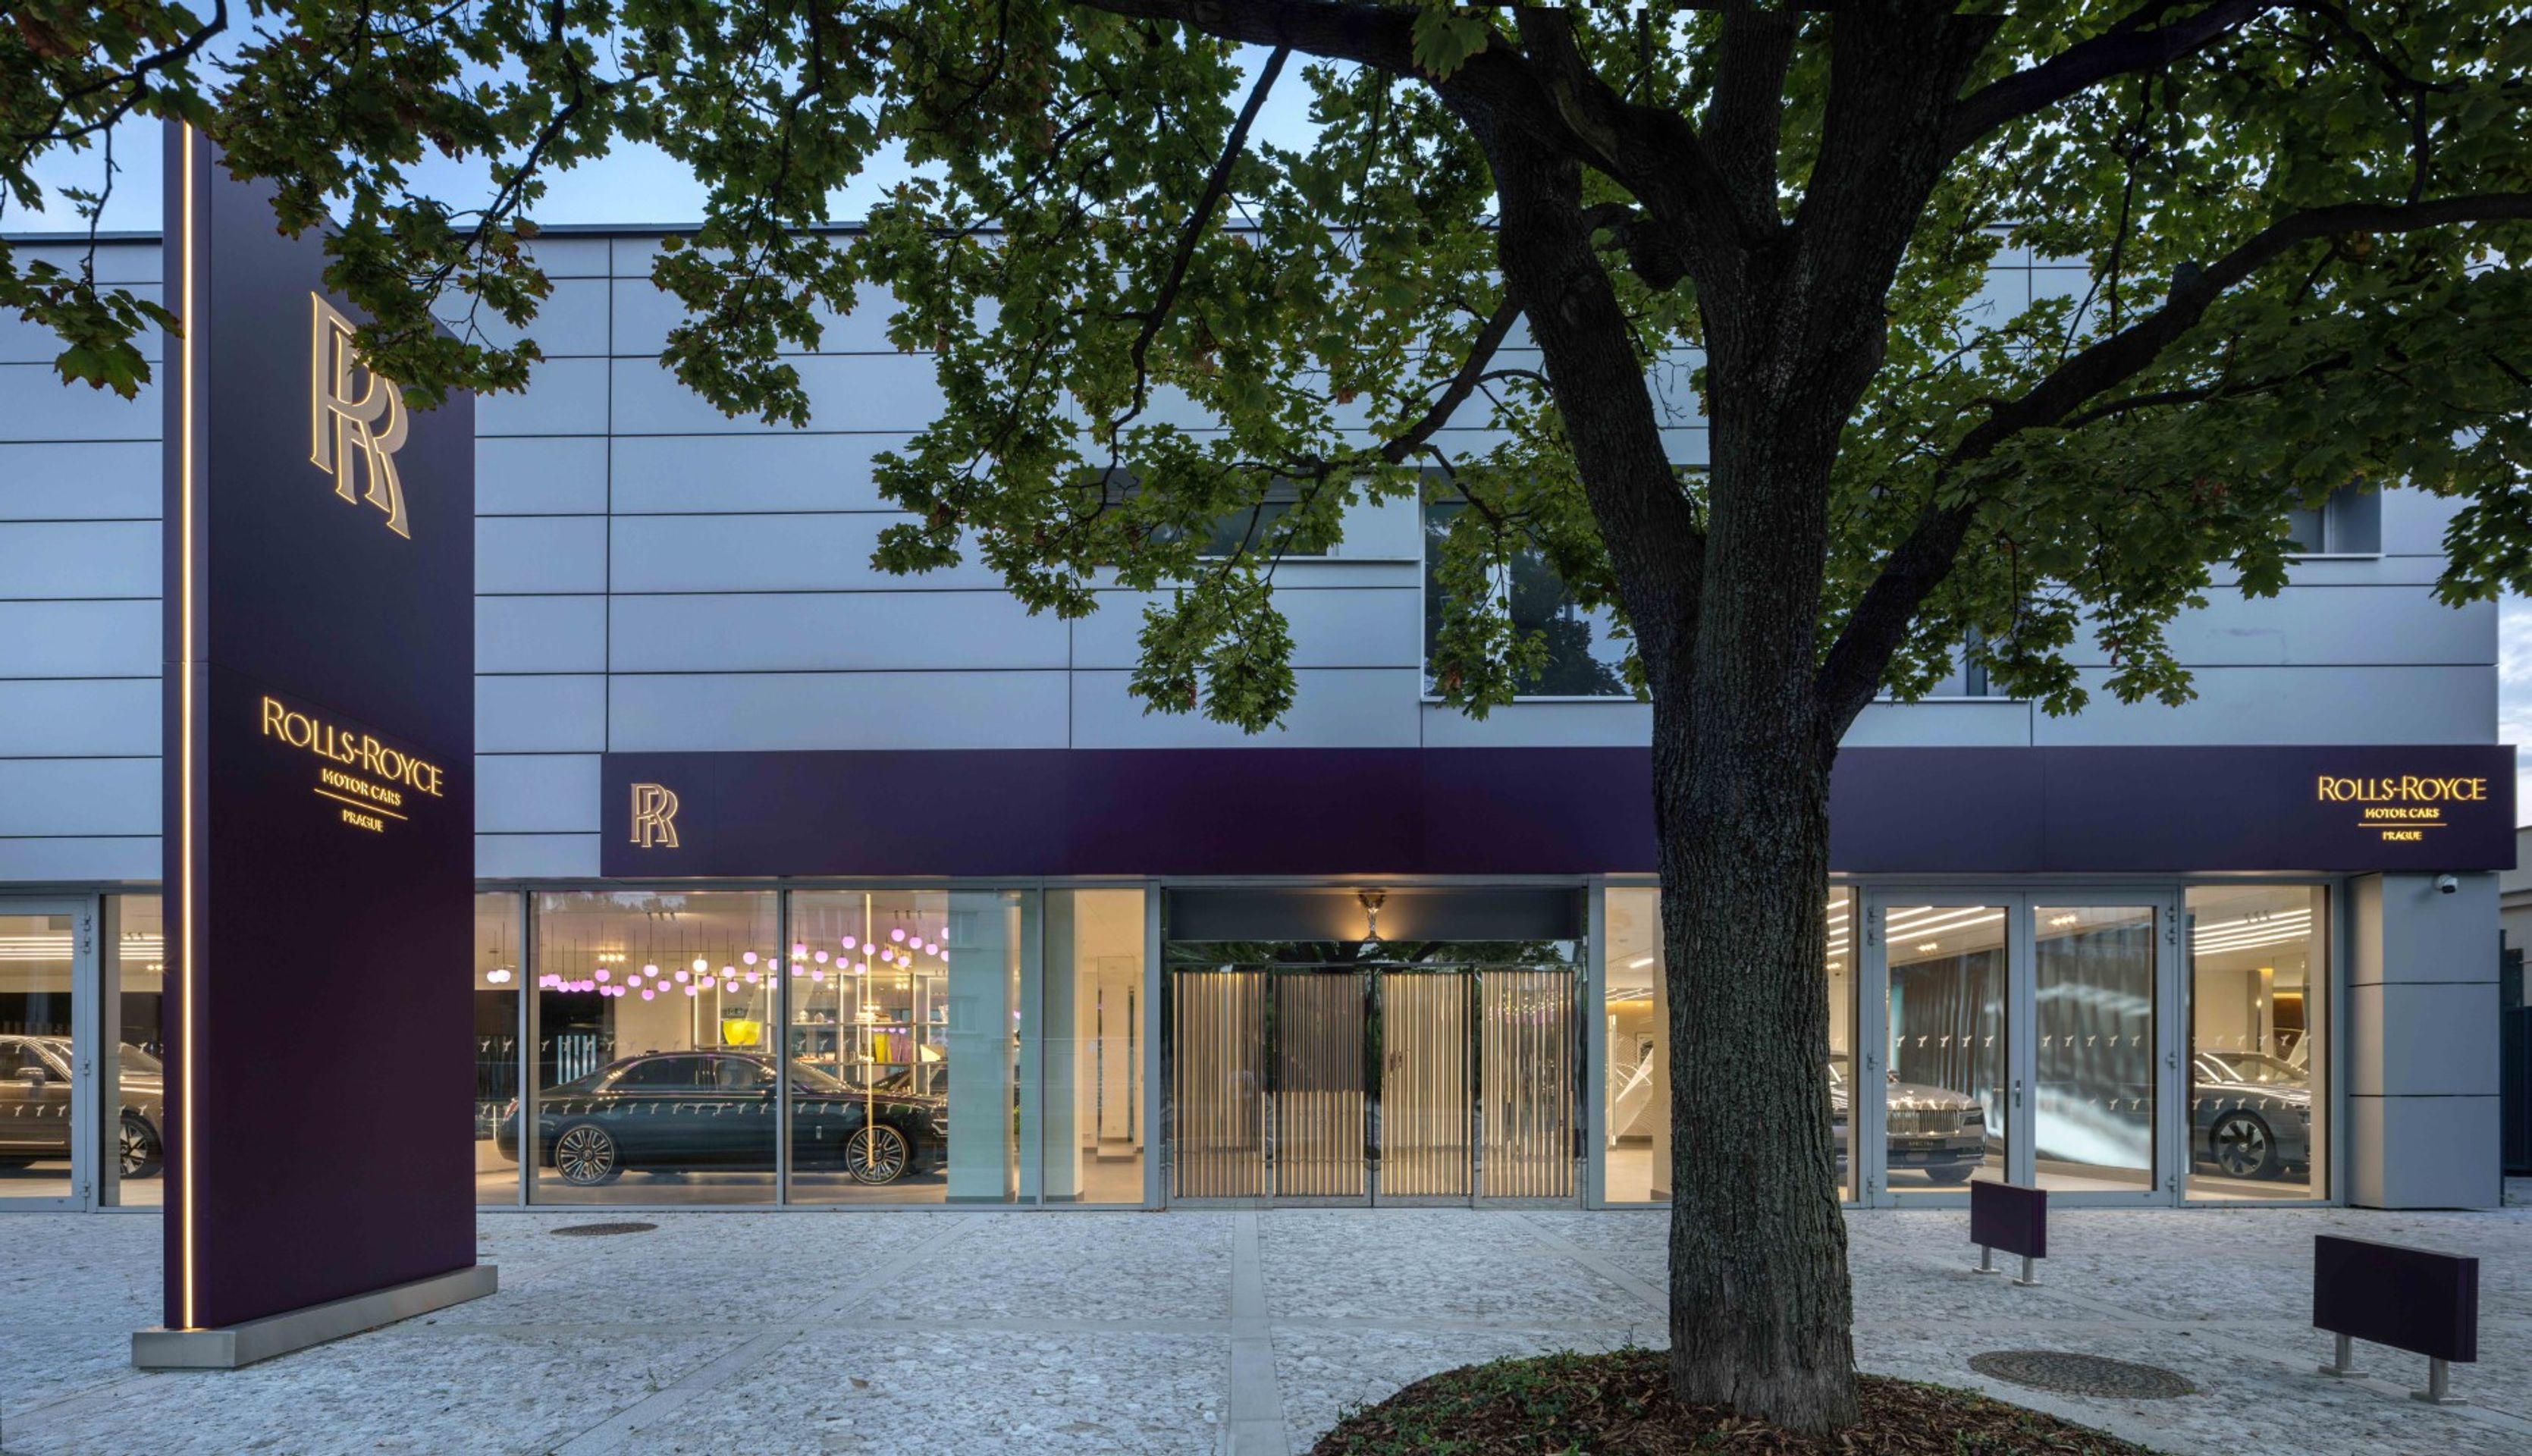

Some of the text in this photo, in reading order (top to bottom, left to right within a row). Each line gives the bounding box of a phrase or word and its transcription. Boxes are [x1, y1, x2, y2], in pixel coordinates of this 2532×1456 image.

[262, 696, 443, 797] ROLLS-ROYCE
[322, 768, 402, 806] MOTOR CARS
[2318, 775, 2488, 801] ROLLS-ROYCE
[343, 809, 384, 833] PRAGUE
[630, 783, 679, 848] RR
[2364, 808, 2439, 819] MOTOR CARS
[2382, 831, 2423, 841] PRAGUE
